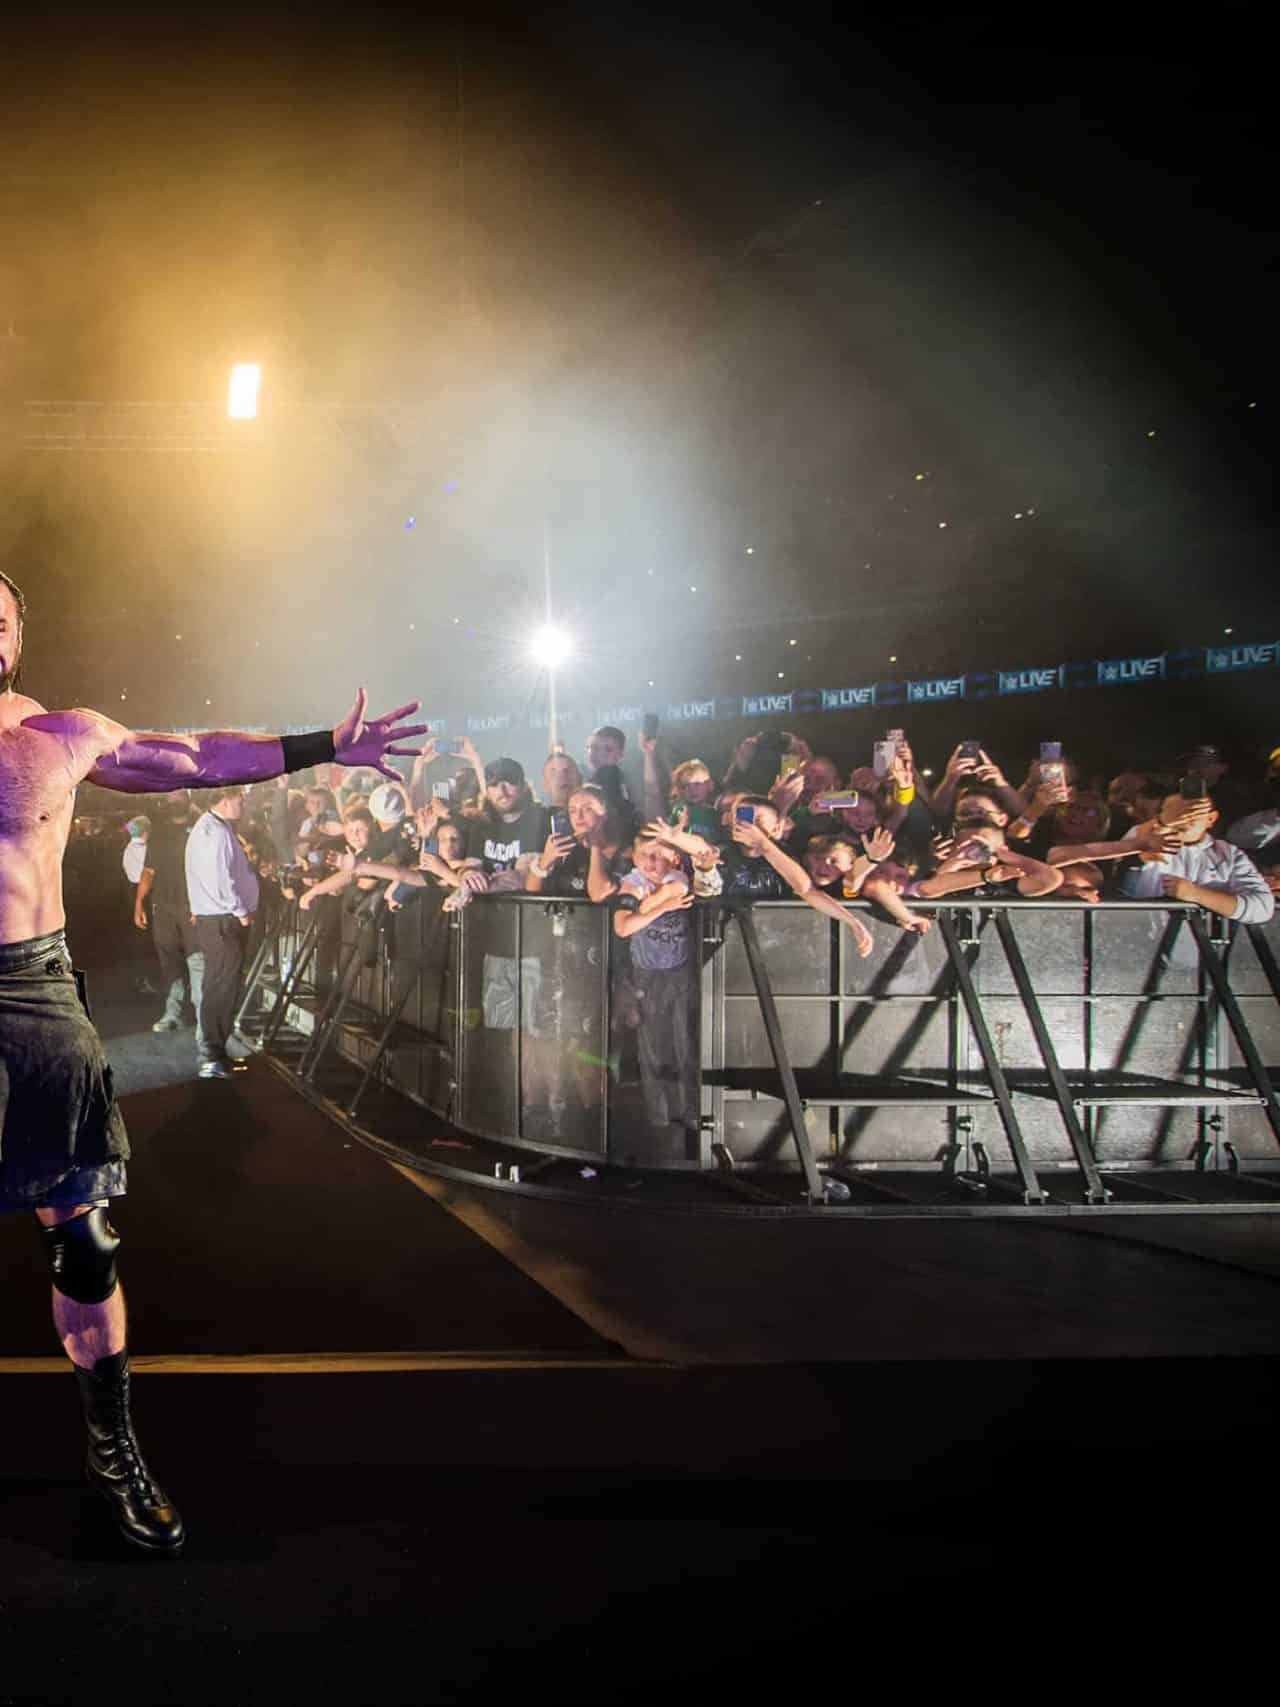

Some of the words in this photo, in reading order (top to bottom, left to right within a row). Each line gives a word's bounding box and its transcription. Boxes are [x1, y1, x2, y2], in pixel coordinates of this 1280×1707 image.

[1231, 644, 1275, 665] LIVE
[1120, 658, 1161, 678] LIVE
[926, 679, 961, 697] LIVE
[1021, 669, 1056, 689] LIVE
[759, 695, 789, 713] LIVE
[840, 687, 871, 704] LIVE
[683, 701, 709, 718] LIVE
